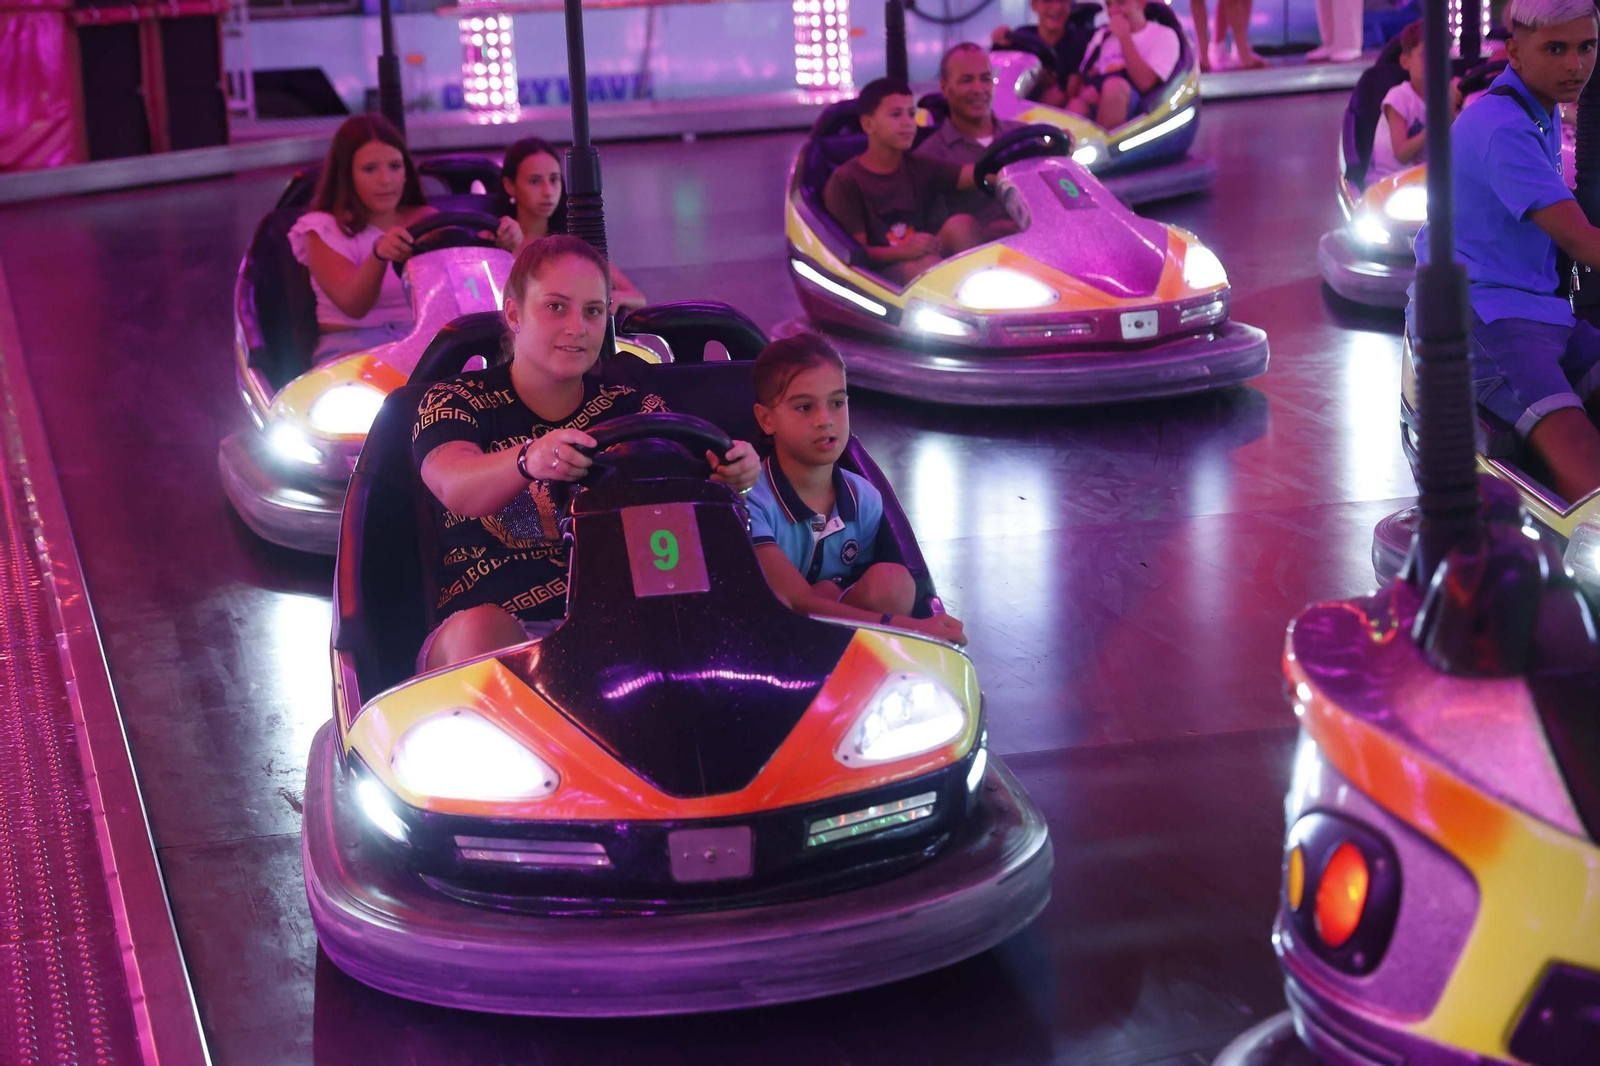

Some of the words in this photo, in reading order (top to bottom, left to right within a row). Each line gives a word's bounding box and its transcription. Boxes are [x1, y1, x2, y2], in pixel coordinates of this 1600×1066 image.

[1059, 178, 1079, 198] 9
[463, 276, 480, 300] 1
[650, 529, 679, 571] 9
